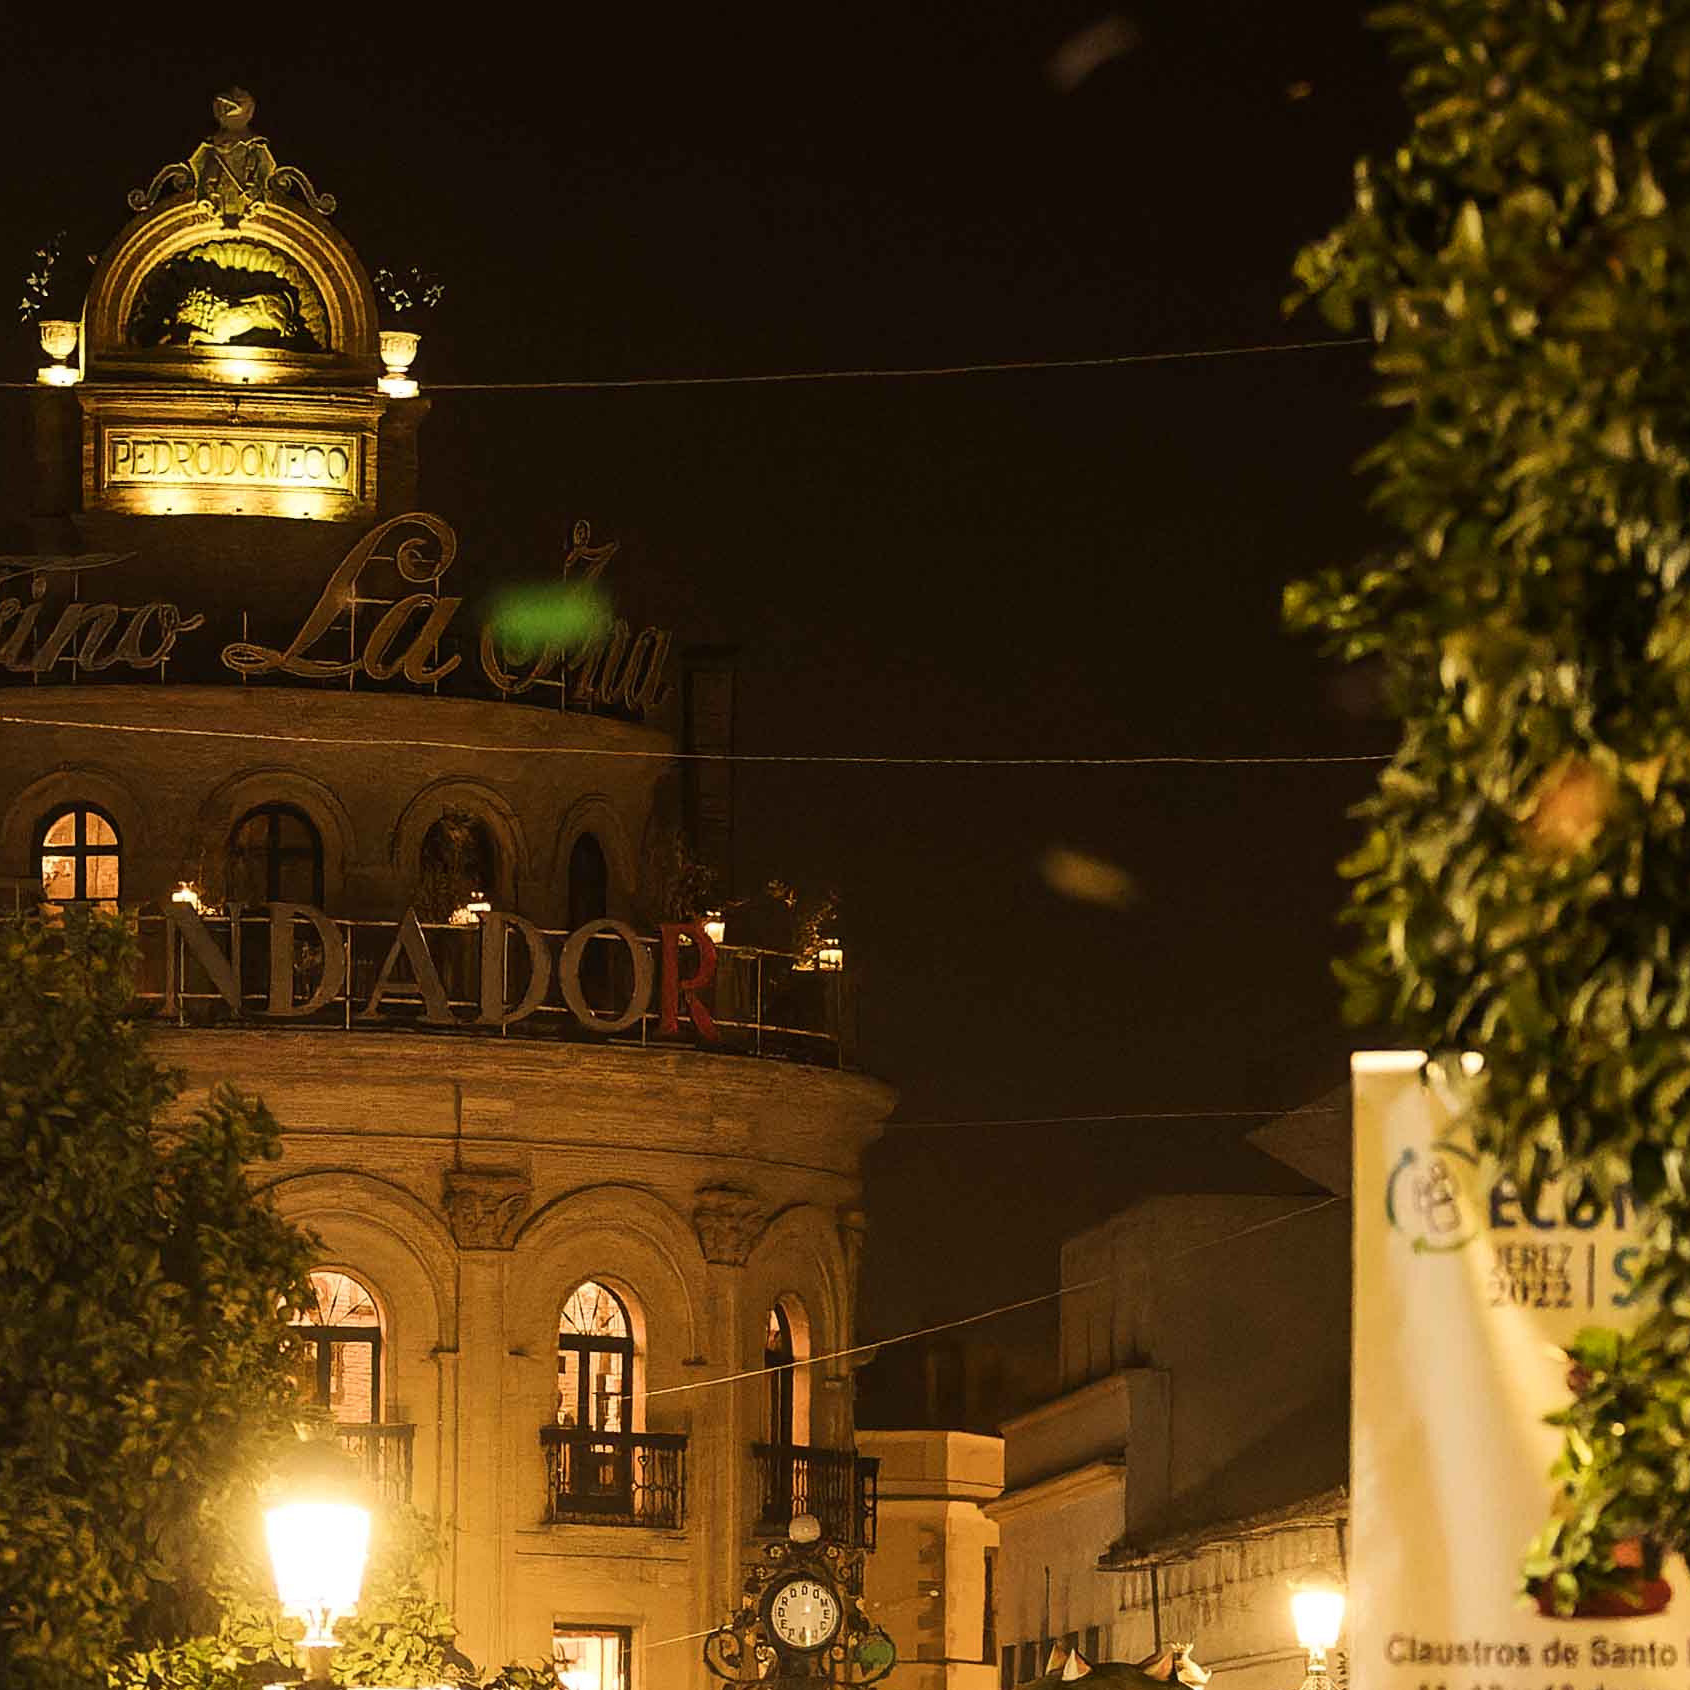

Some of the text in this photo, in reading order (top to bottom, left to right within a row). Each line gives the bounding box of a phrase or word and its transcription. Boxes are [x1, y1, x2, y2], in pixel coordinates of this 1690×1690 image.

[221, 511, 463, 684] La
[1490, 1279, 1573, 1308] 2022
[1385, 1633, 1532, 1667] Claustros
[1541, 1637, 1579, 1667] de
[1589, 1637, 1678, 1667] Santo
